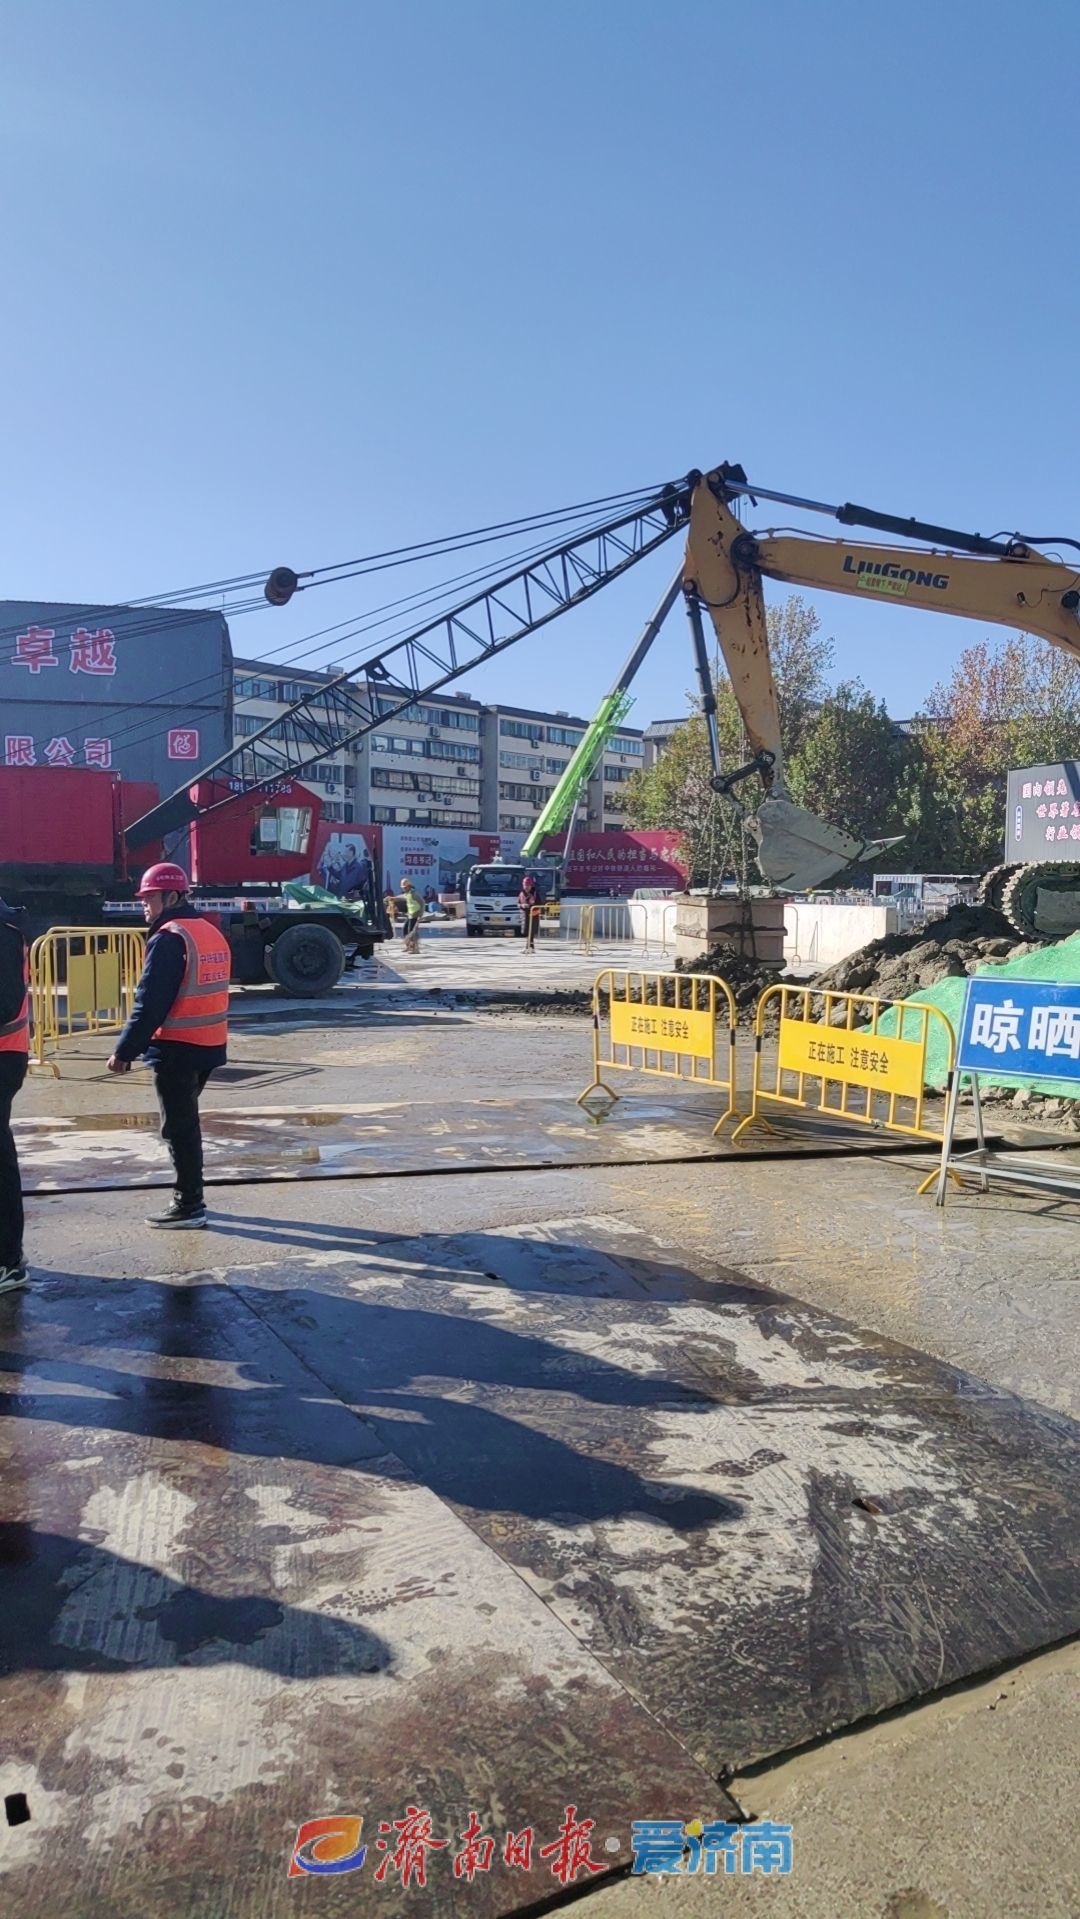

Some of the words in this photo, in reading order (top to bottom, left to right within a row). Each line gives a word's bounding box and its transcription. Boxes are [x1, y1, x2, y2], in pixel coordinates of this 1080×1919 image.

[11, 625, 117, 675] 卓越
[5, 736, 112, 768] 限公司
[631, 1016, 657, 1035] 正在施工
[661, 1019, 689, 1039] 注意安全
[969, 999, 1080, 1059] 晾晒
[808, 1041, 845, 1064] 正在施工
[850, 1047, 889, 1074] 注意安全
